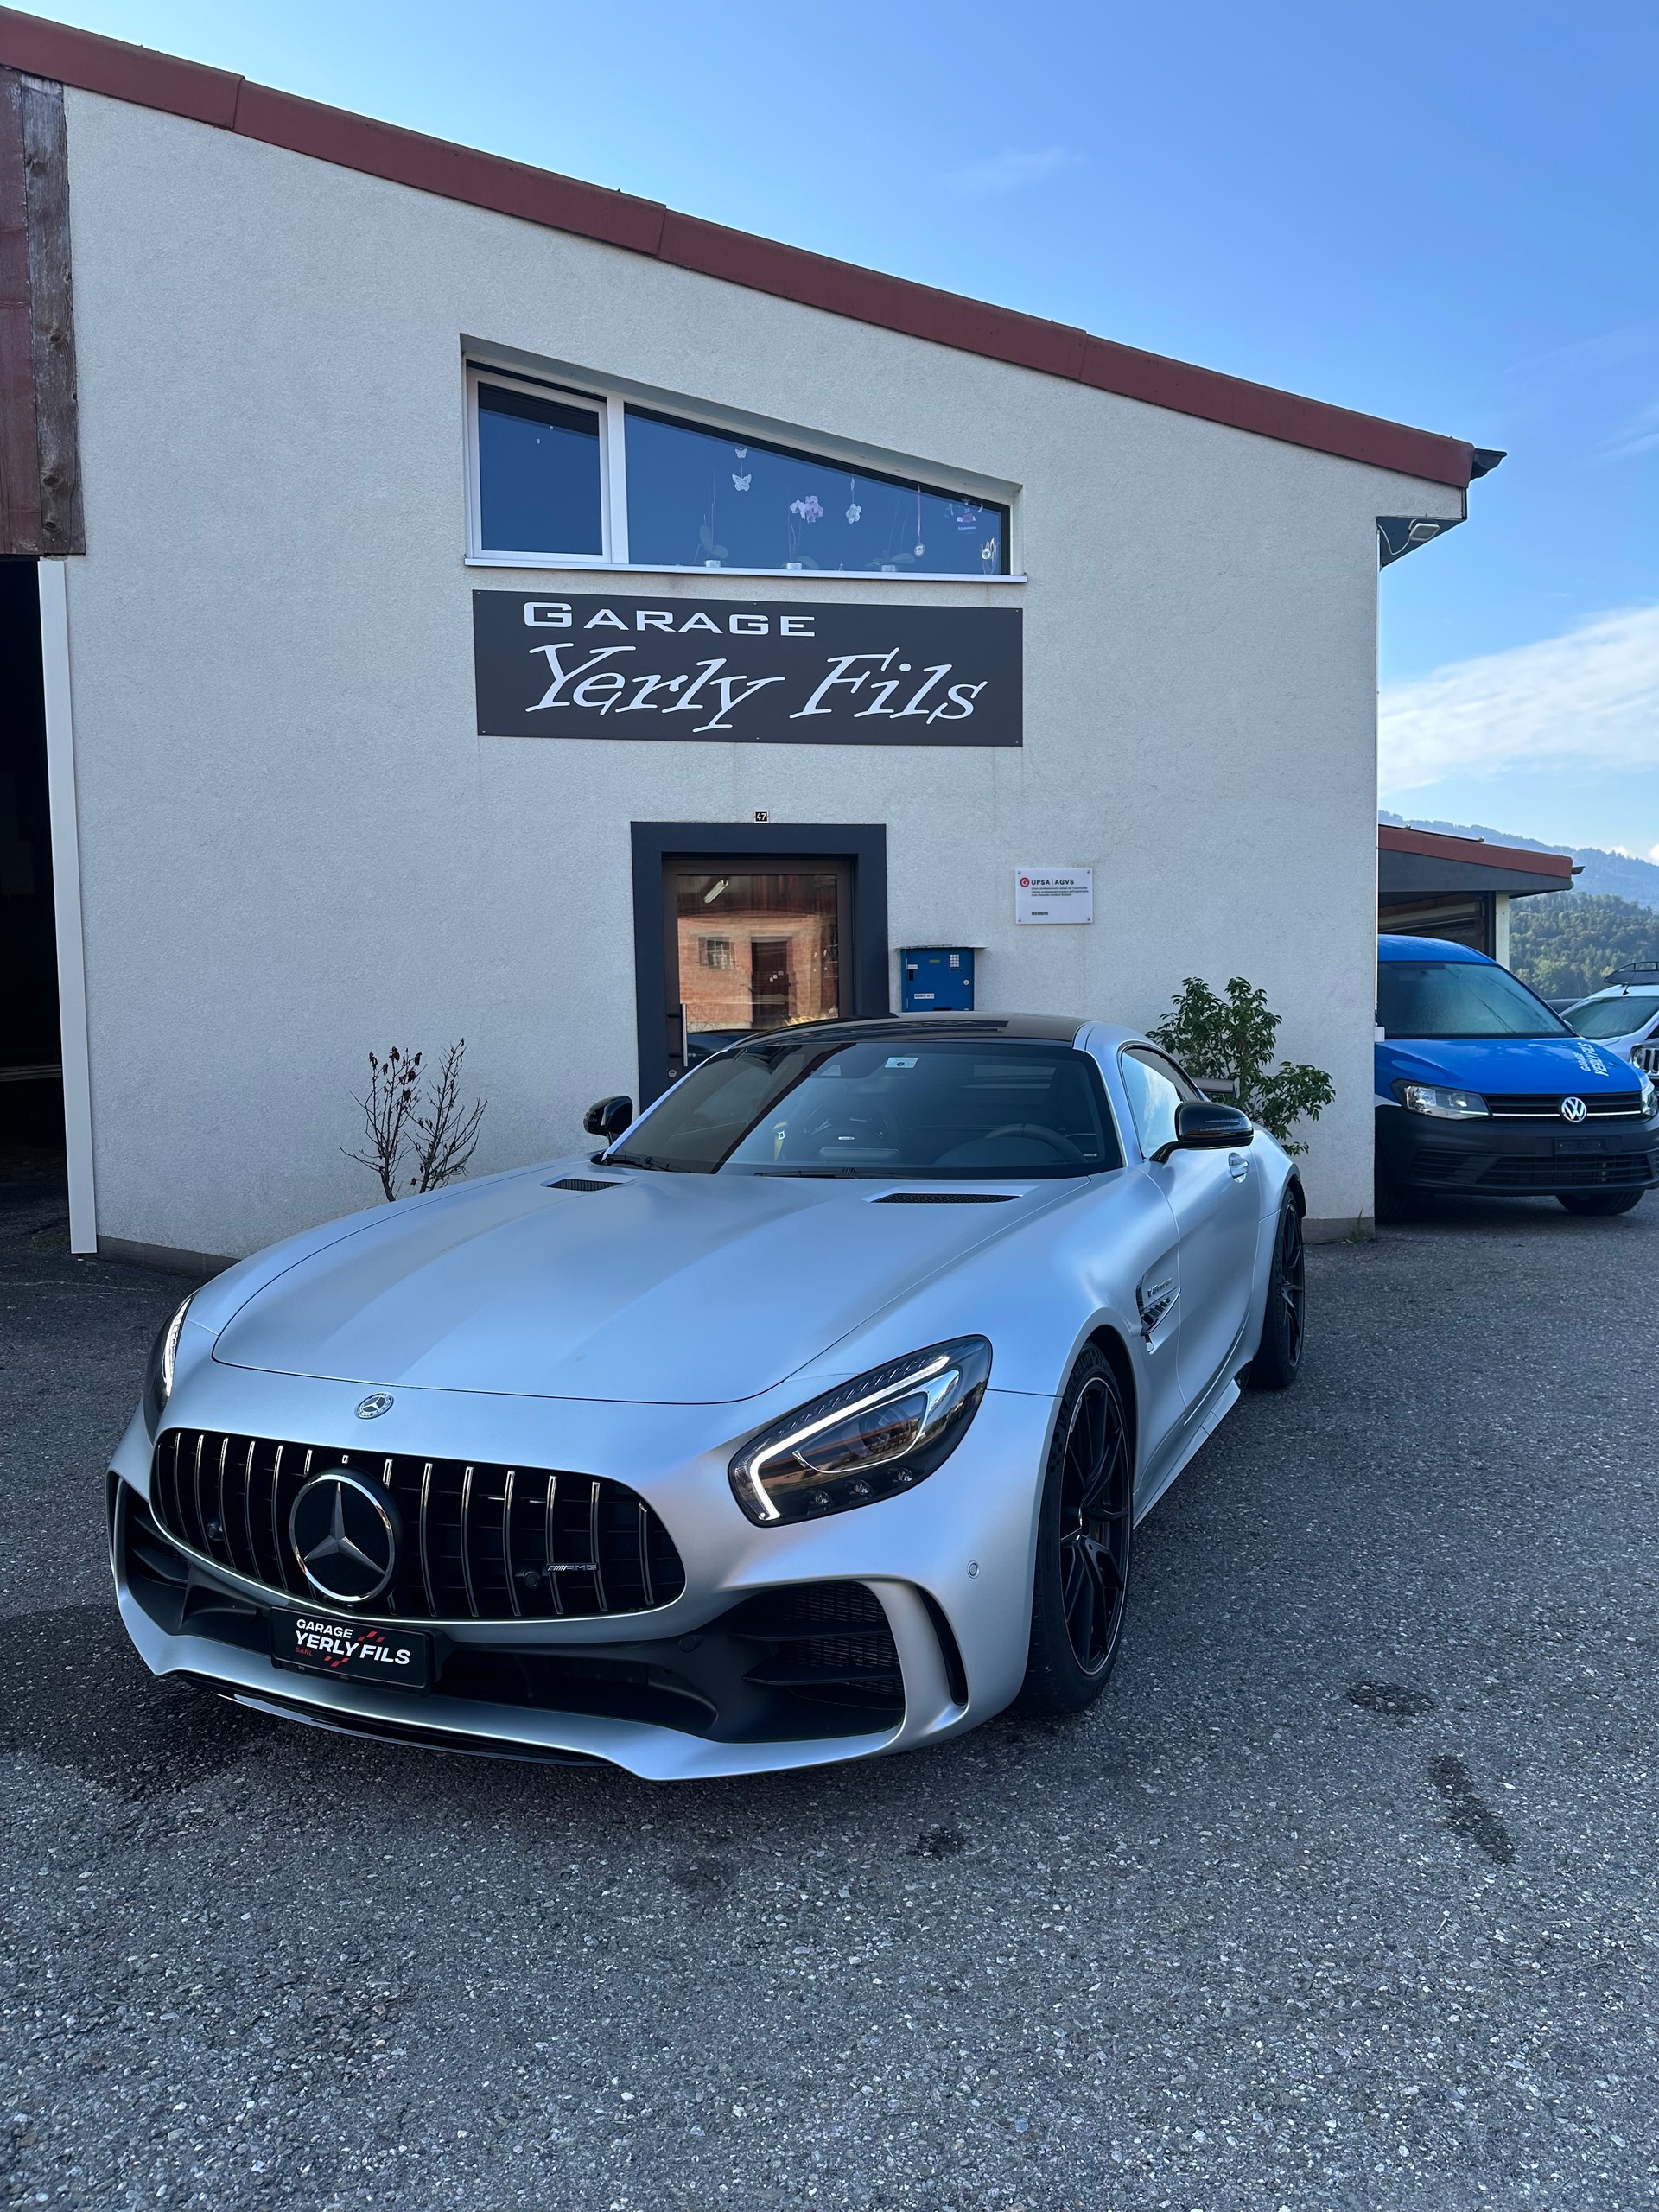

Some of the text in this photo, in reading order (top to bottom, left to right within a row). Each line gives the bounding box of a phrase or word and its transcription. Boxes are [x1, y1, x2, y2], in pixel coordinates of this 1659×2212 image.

[524, 601, 816, 637] GARAGE
[525, 642, 988, 733] Yerly Fils
[1561, 1096, 1587, 1122] VW
[1065, 1349, 1092, 1403] MICHELIN
[296, 1618, 353, 1639] GARAGE
[295, 1646, 313, 1656] SARL
[296, 1630, 411, 1665] YERLY FILS
